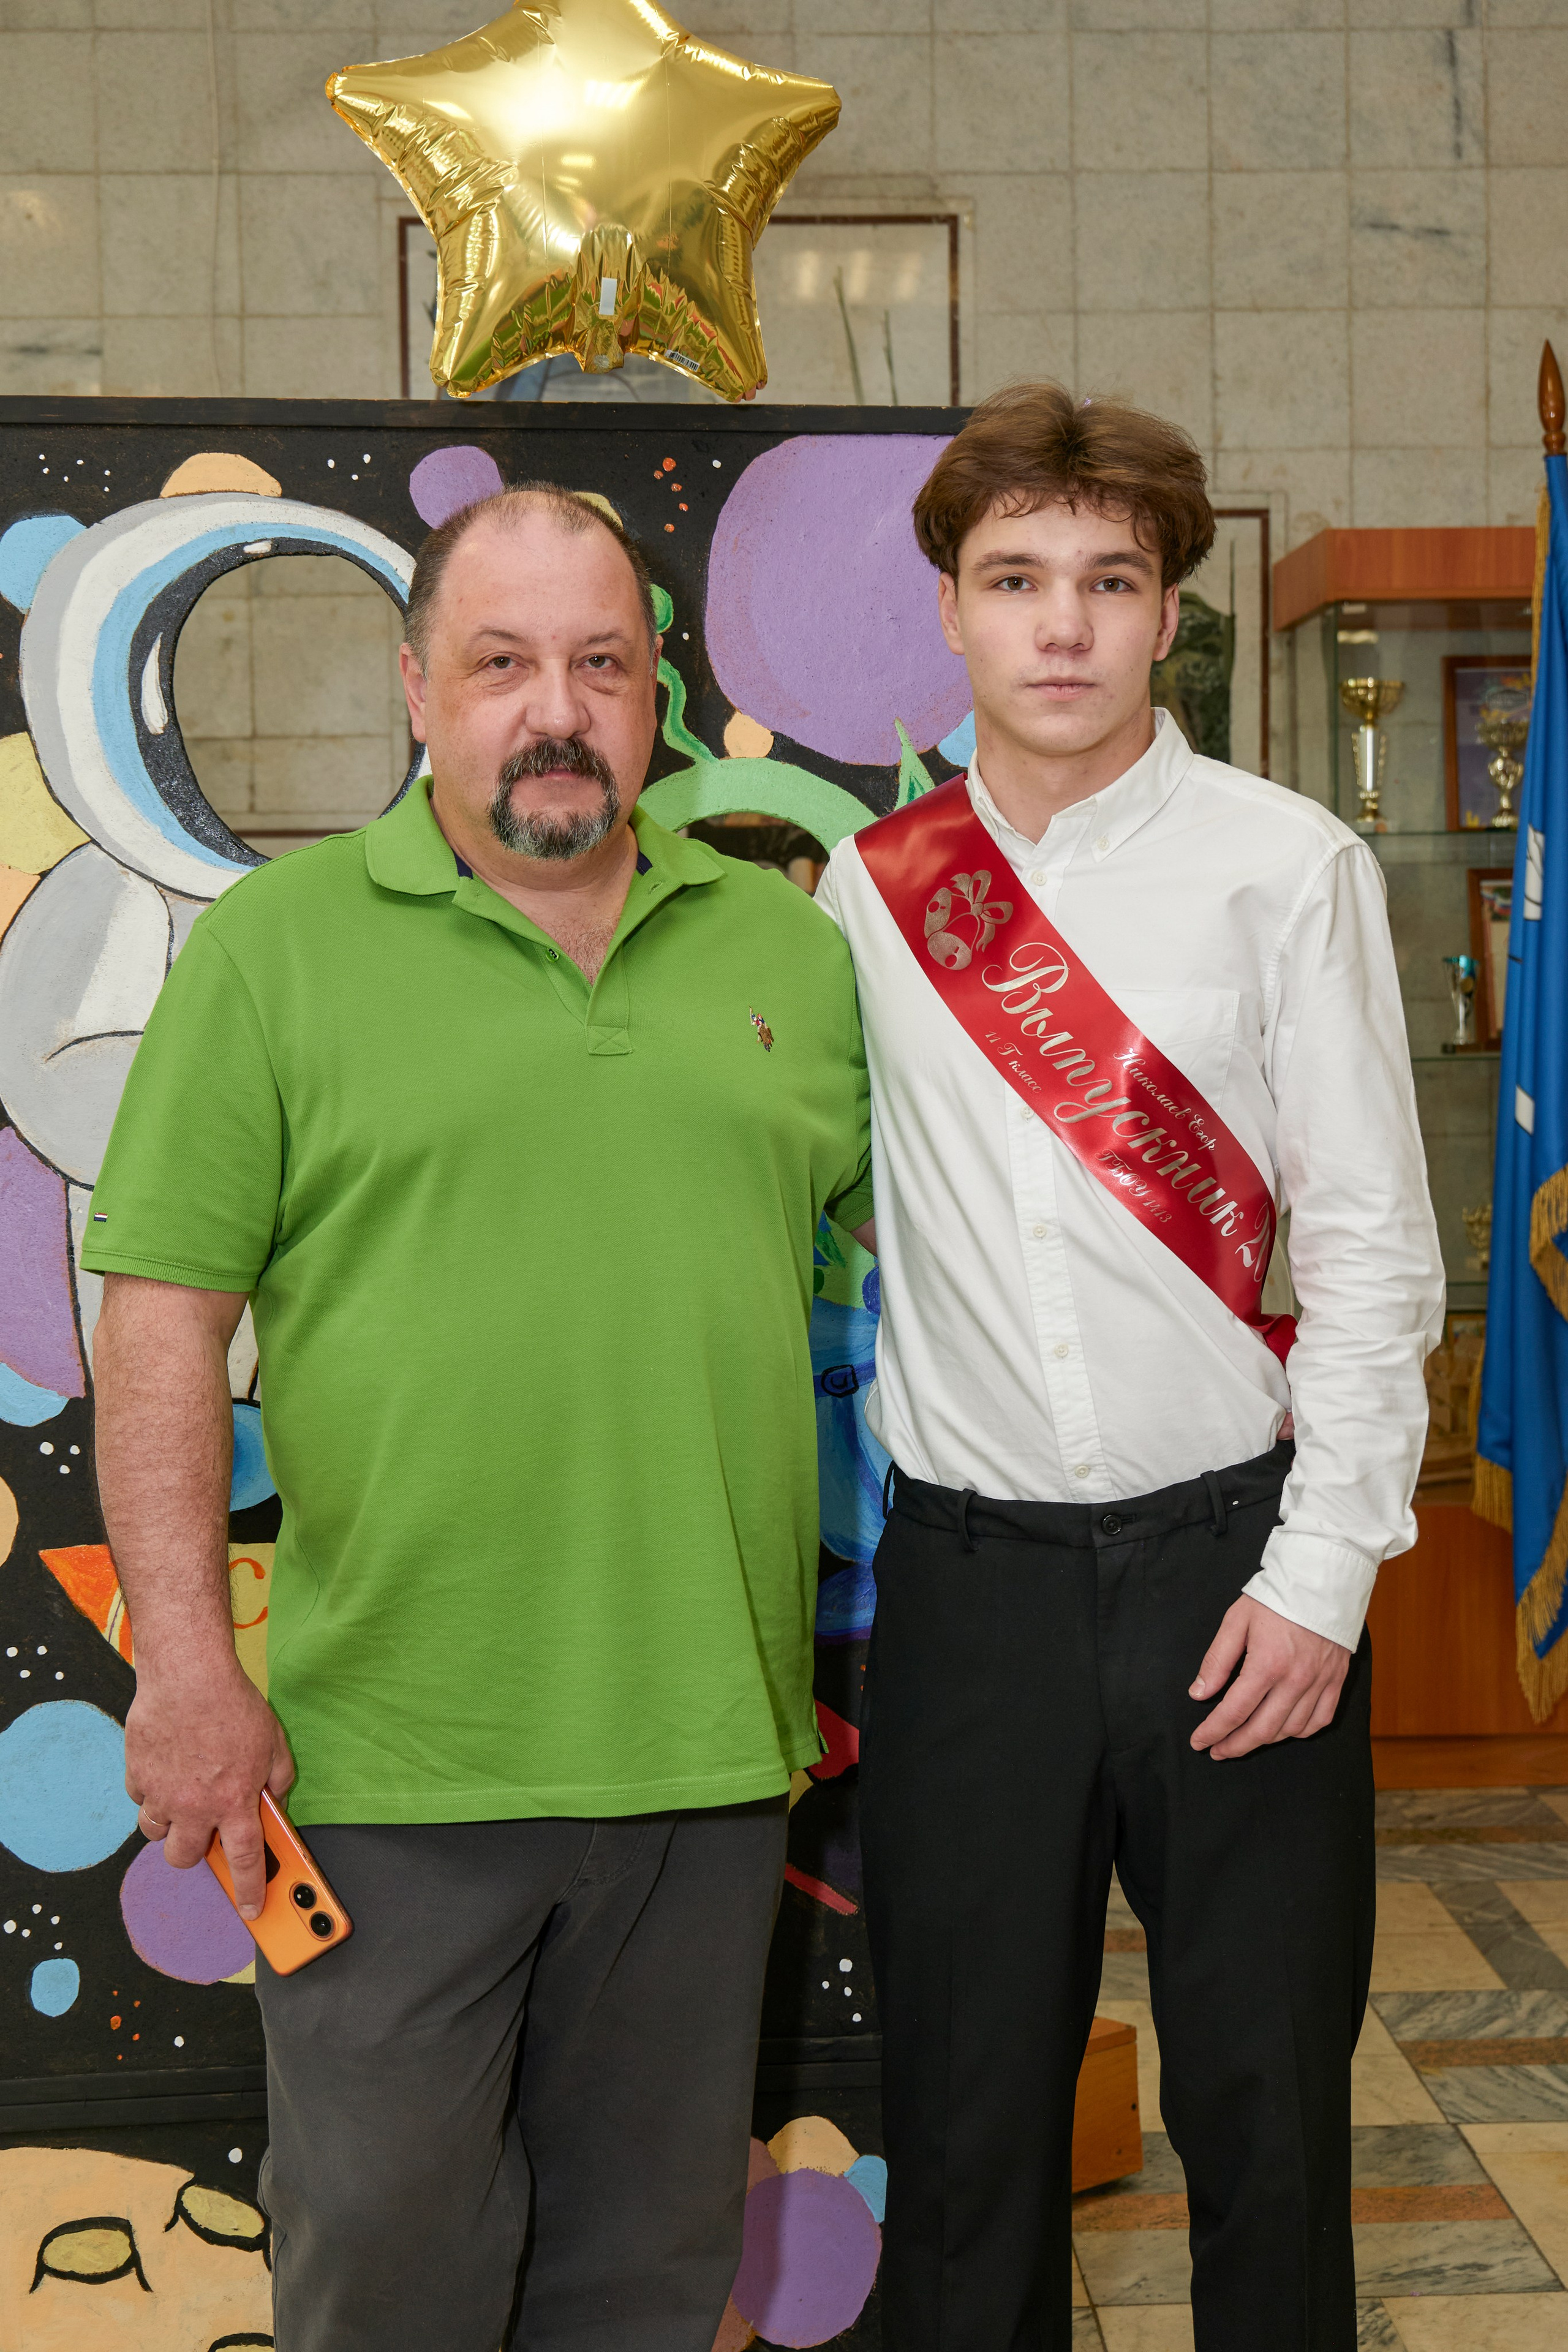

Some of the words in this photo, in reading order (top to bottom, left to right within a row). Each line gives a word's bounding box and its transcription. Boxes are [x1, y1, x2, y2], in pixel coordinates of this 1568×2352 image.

[981, 941, 1245, 1237] Выпускник
[985, 1031, 1001, 1044] 11
[1008, 1060, 1042, 1093] класс
[1113, 1047, 1192, 1120] Николаев
[1188, 1114, 1217, 1151] Егор
[1094, 1148, 1153, 1197] ГБОУ
[1142, 1199, 1172, 1223] 1413
